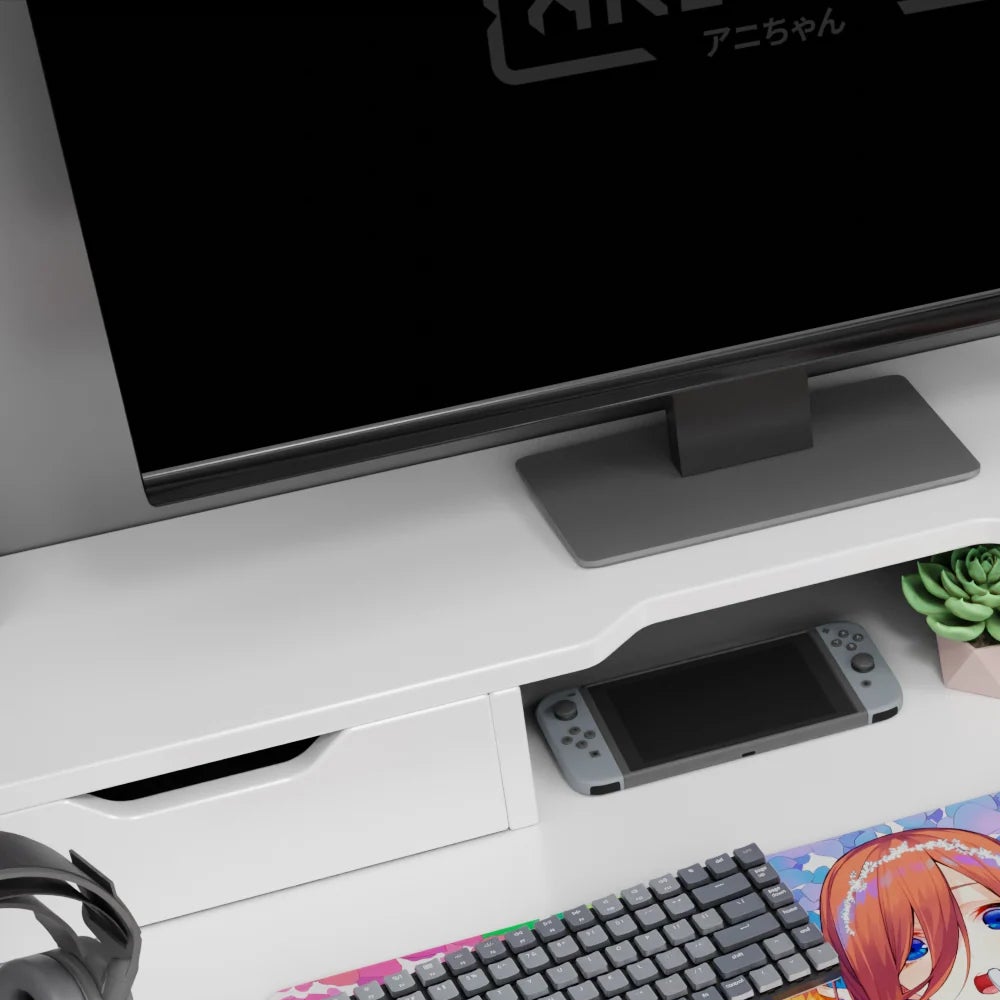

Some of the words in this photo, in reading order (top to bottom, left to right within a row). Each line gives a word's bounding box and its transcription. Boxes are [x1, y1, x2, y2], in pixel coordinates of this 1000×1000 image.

[703, 7, 846, 57] アニちゃん
